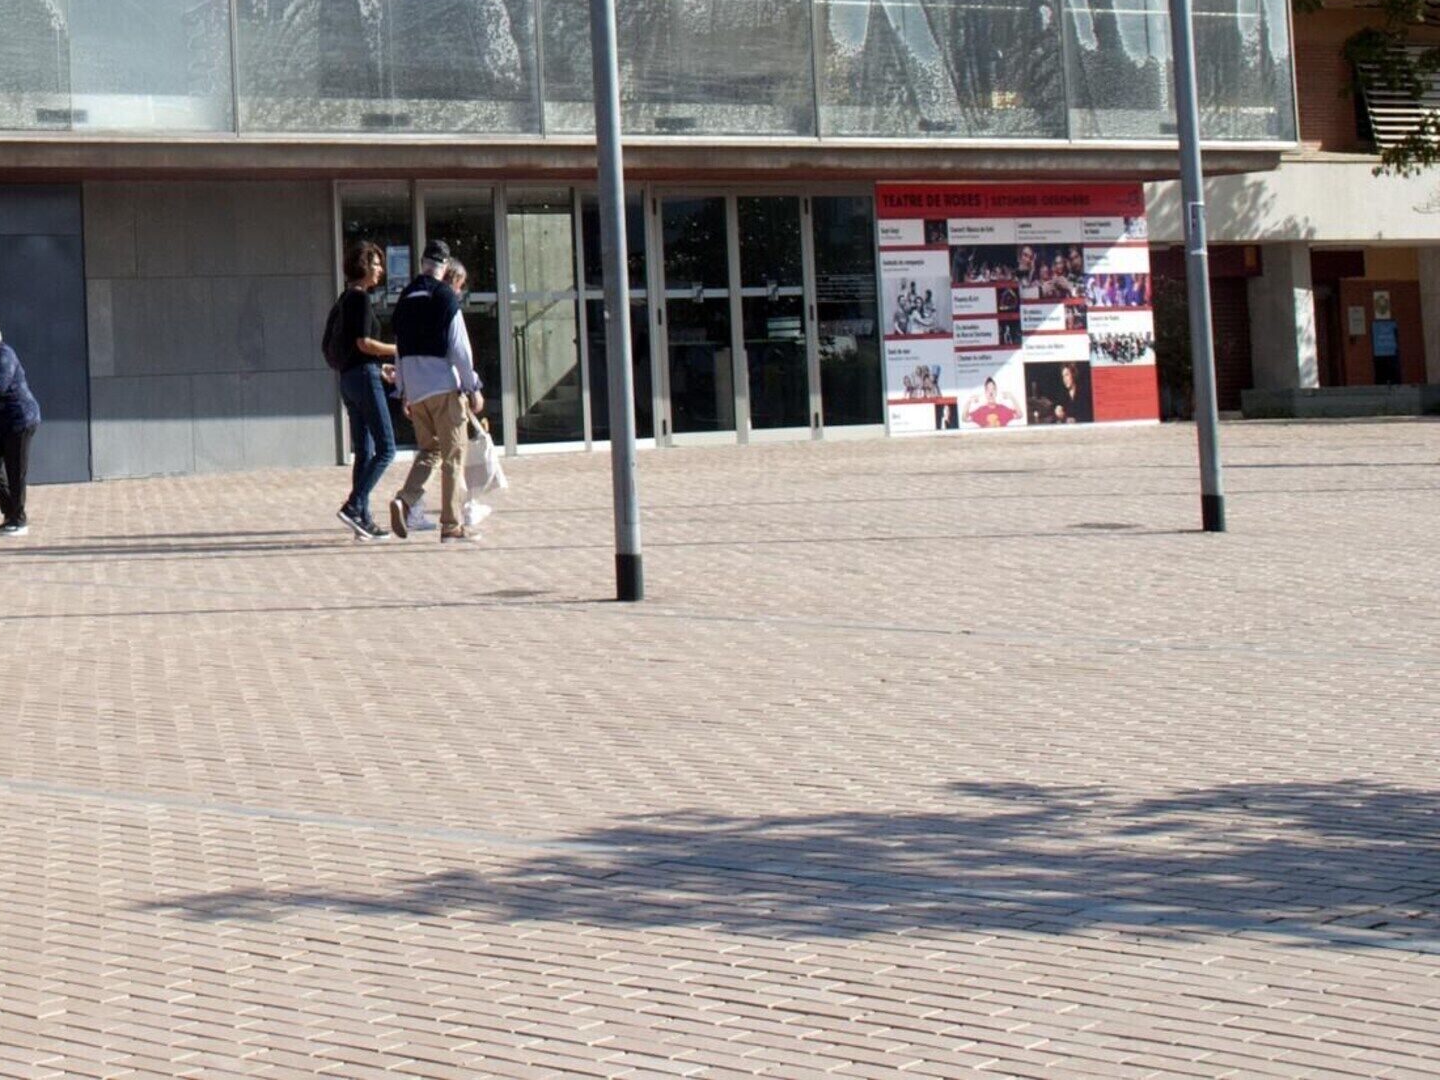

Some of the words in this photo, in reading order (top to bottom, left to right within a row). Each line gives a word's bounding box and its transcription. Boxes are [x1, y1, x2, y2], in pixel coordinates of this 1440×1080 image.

[882, 194, 923, 208] TEATRE
[927, 194, 941, 208] DE
[944, 193, 981, 207] ROSES
